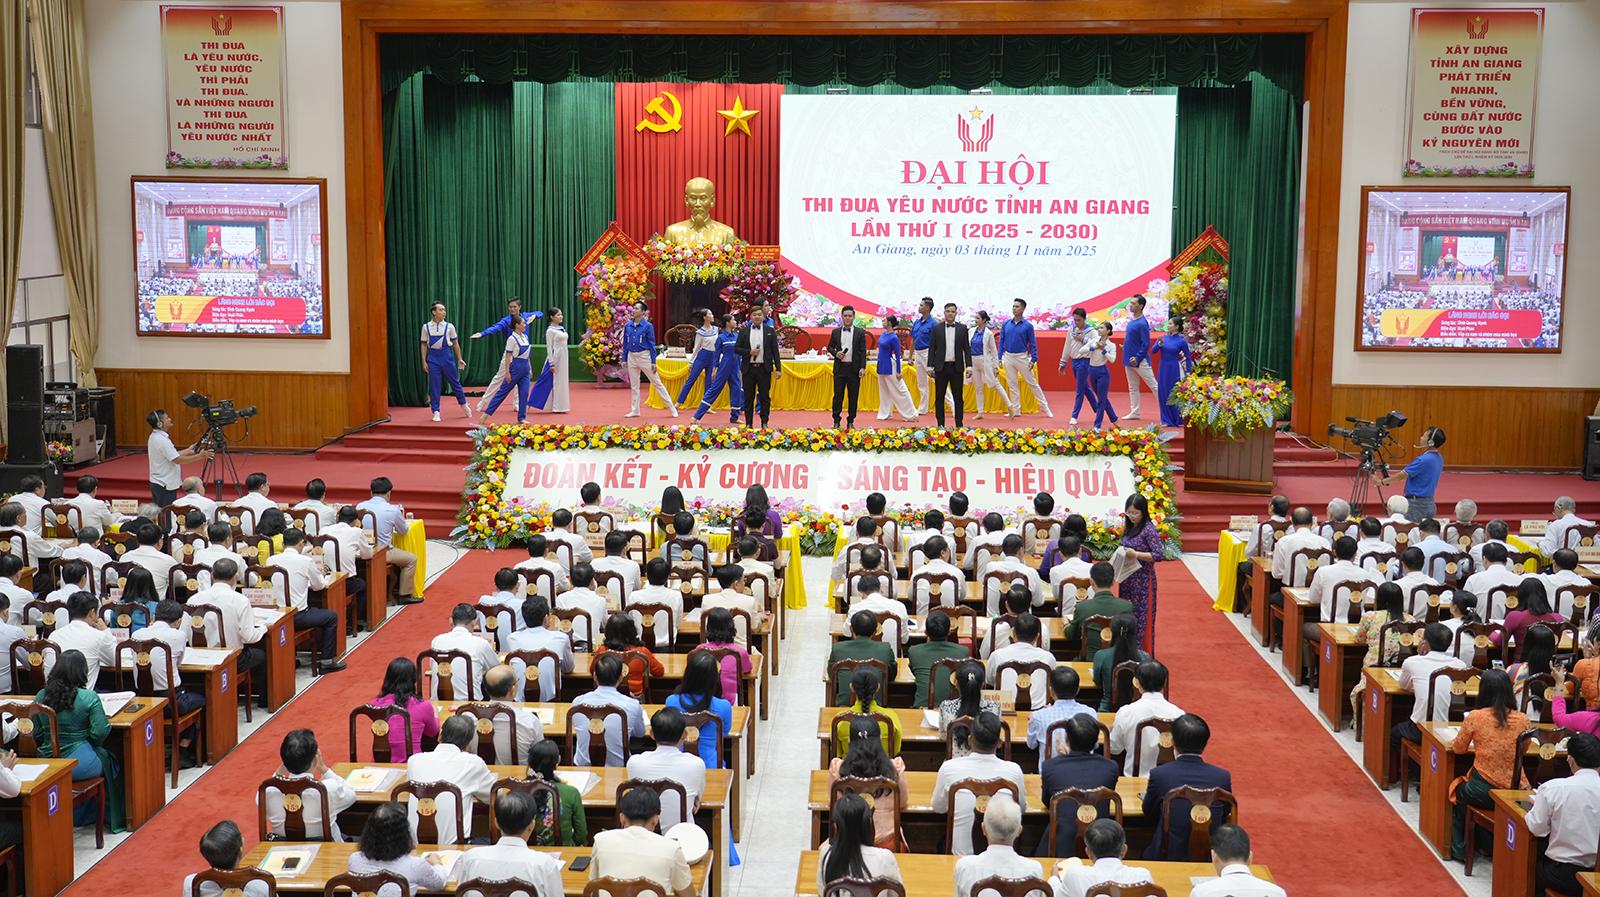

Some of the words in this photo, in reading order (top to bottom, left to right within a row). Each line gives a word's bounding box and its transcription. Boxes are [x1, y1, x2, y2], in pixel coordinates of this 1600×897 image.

[201, 42, 219, 50] THI
[222, 42, 245, 50] ĐUA
[1445, 45, 1470, 54] XÂY
[1473, 46, 1508, 56] DỰNG
[202, 52, 224, 61] YÊU
[1430, 57, 1458, 68] TỈNH
[1462, 59, 1480, 68] AN
[1483, 59, 1522, 68] GIANG
[195, 63, 217, 72] YÊU
[220, 63, 253, 73] NƯỚC
[221, 75, 249, 84] PHẢI
[1439, 70, 1472, 81] PHÁT
[1476, 70, 1511, 81] TRIỂN
[176, 97, 191, 106] VÀ
[194, 97, 235, 107] NHỮNG
[238, 98, 274, 107] NGƯỜI
[1423, 110, 1457, 121] CÙNG
[1461, 110, 1484, 121] ĐẤT
[1488, 111, 1523, 121] NƯỚC
[194, 120, 235, 130] NHỮNG
[238, 121, 274, 130] NGƯỜI
[1441, 125, 1475, 134] BƯỚC
[1478, 125, 1503, 134] VÀO
[181, 132, 202, 141] YÊU
[206, 132, 238, 141] NƯỚC
[241, 131, 272, 141] NHẤT
[1442, 138, 1492, 148] NGUYÊN
[1495, 138, 1520, 148] MỚI
[900, 160, 967, 191] ĐẠI
[977, 153, 1050, 191] HỘI
[802, 197, 833, 212] THI
[840, 197, 880, 213] ĐUA
[887, 195, 925, 213] YÊU
[932, 195, 988, 214] NƯỚC
[995, 194, 1042, 214] TỈNH
[1049, 199, 1078, 214] AN
[1086, 199, 1150, 215] GIANG
[851, 217, 890, 237] LẦN
[897, 220, 938, 238] THỨ
[943, 223, 953, 238] I
[961, 223, 1019, 240] (2025
[1040, 224, 1098, 241] 2030)
[852, 244, 871, 255] An
[875, 243, 917, 257] Giang,
[921, 244, 951, 257] ngày
[955, 244, 970, 255] 03
[974, 245, 1011, 258] tháng
[1016, 245, 1029, 256] 11
[1034, 246, 1062, 257] năm
[1066, 245, 1098, 257] 2025
[523, 457, 596, 489] ĐOÀN
[603, 454, 652, 489] KẾT
[677, 454, 712, 489] KỶ
[719, 461, 809, 490] CƯƠNG
[837, 458, 909, 492] SÁNG
[917, 465, 967, 498] TẠO
[995, 462, 1055, 500] HIỆU
[1064, 461, 1120, 499] QUẢ
[280, 629, 286, 643] A
[1326, 646, 1331, 660] A
[222, 673, 228, 688] B
[1372, 692, 1378, 708] B
[146, 724, 153, 741] C
[1431, 751, 1437, 768] C
[49, 791, 57, 811] D
[1507, 823, 1514, 844] D
